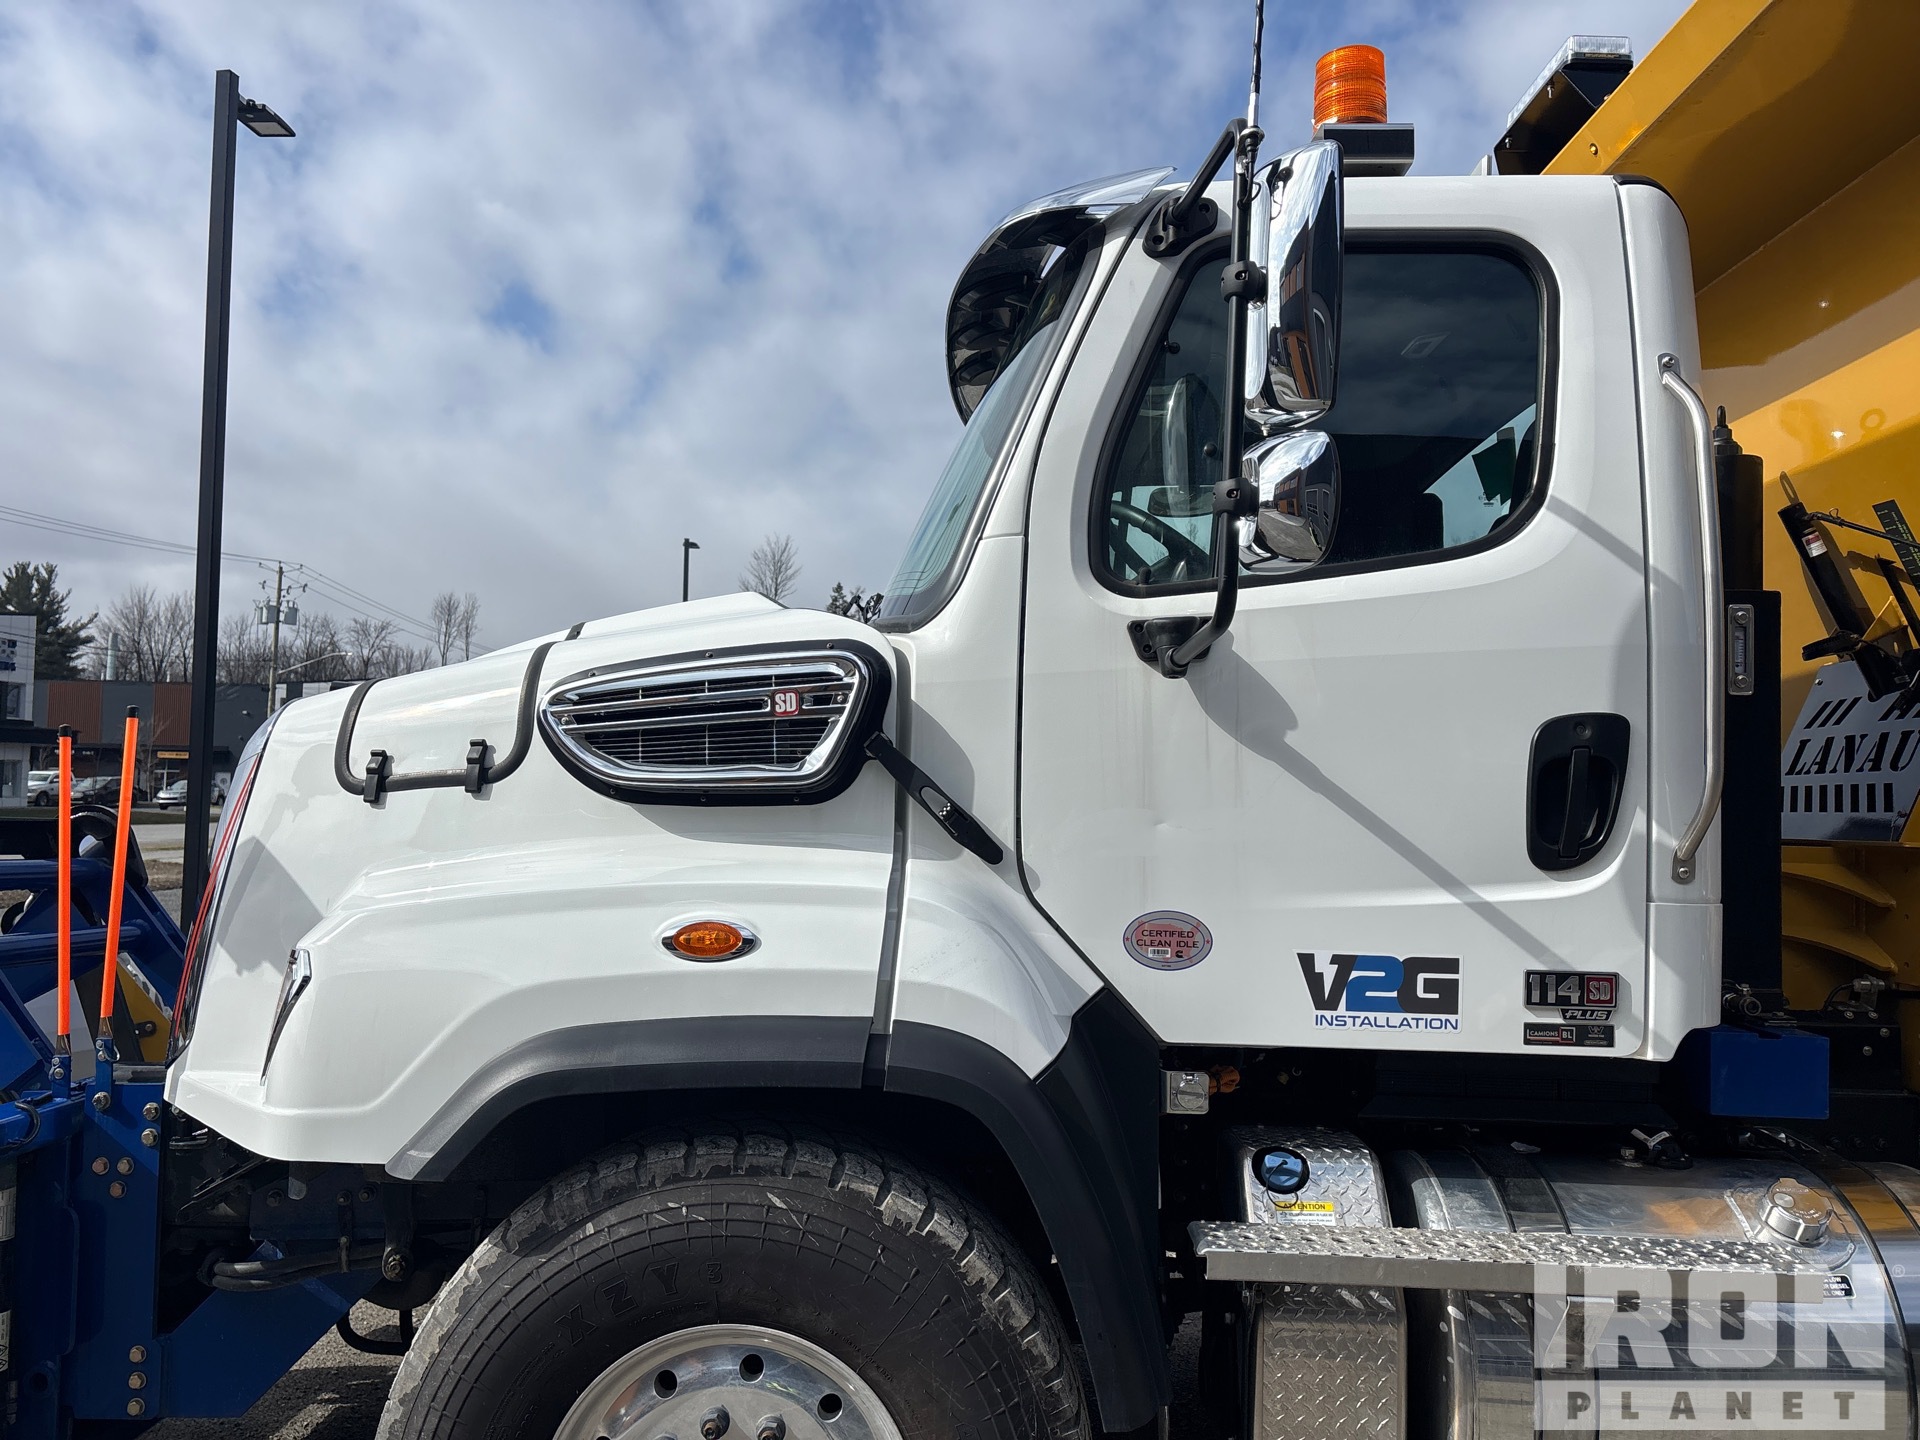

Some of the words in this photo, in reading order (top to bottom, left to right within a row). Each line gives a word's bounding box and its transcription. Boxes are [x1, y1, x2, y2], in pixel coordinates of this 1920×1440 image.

[775, 692, 796, 712] SD
[1141, 929, 1194, 939] CERTIFIED
[1136, 939, 1172, 948] CLEAN
[1176, 940, 1199, 949] IDLE
[1296, 952, 1460, 1015] V2G
[1529, 974, 1581, 1005] 114
[1589, 981, 1611, 1001] SD
[1564, 1010, 1608, 1020] PLUS
[1315, 1014, 1459, 1031] INSTALLATION
[1562, 1030, 1573, 1039] BL
